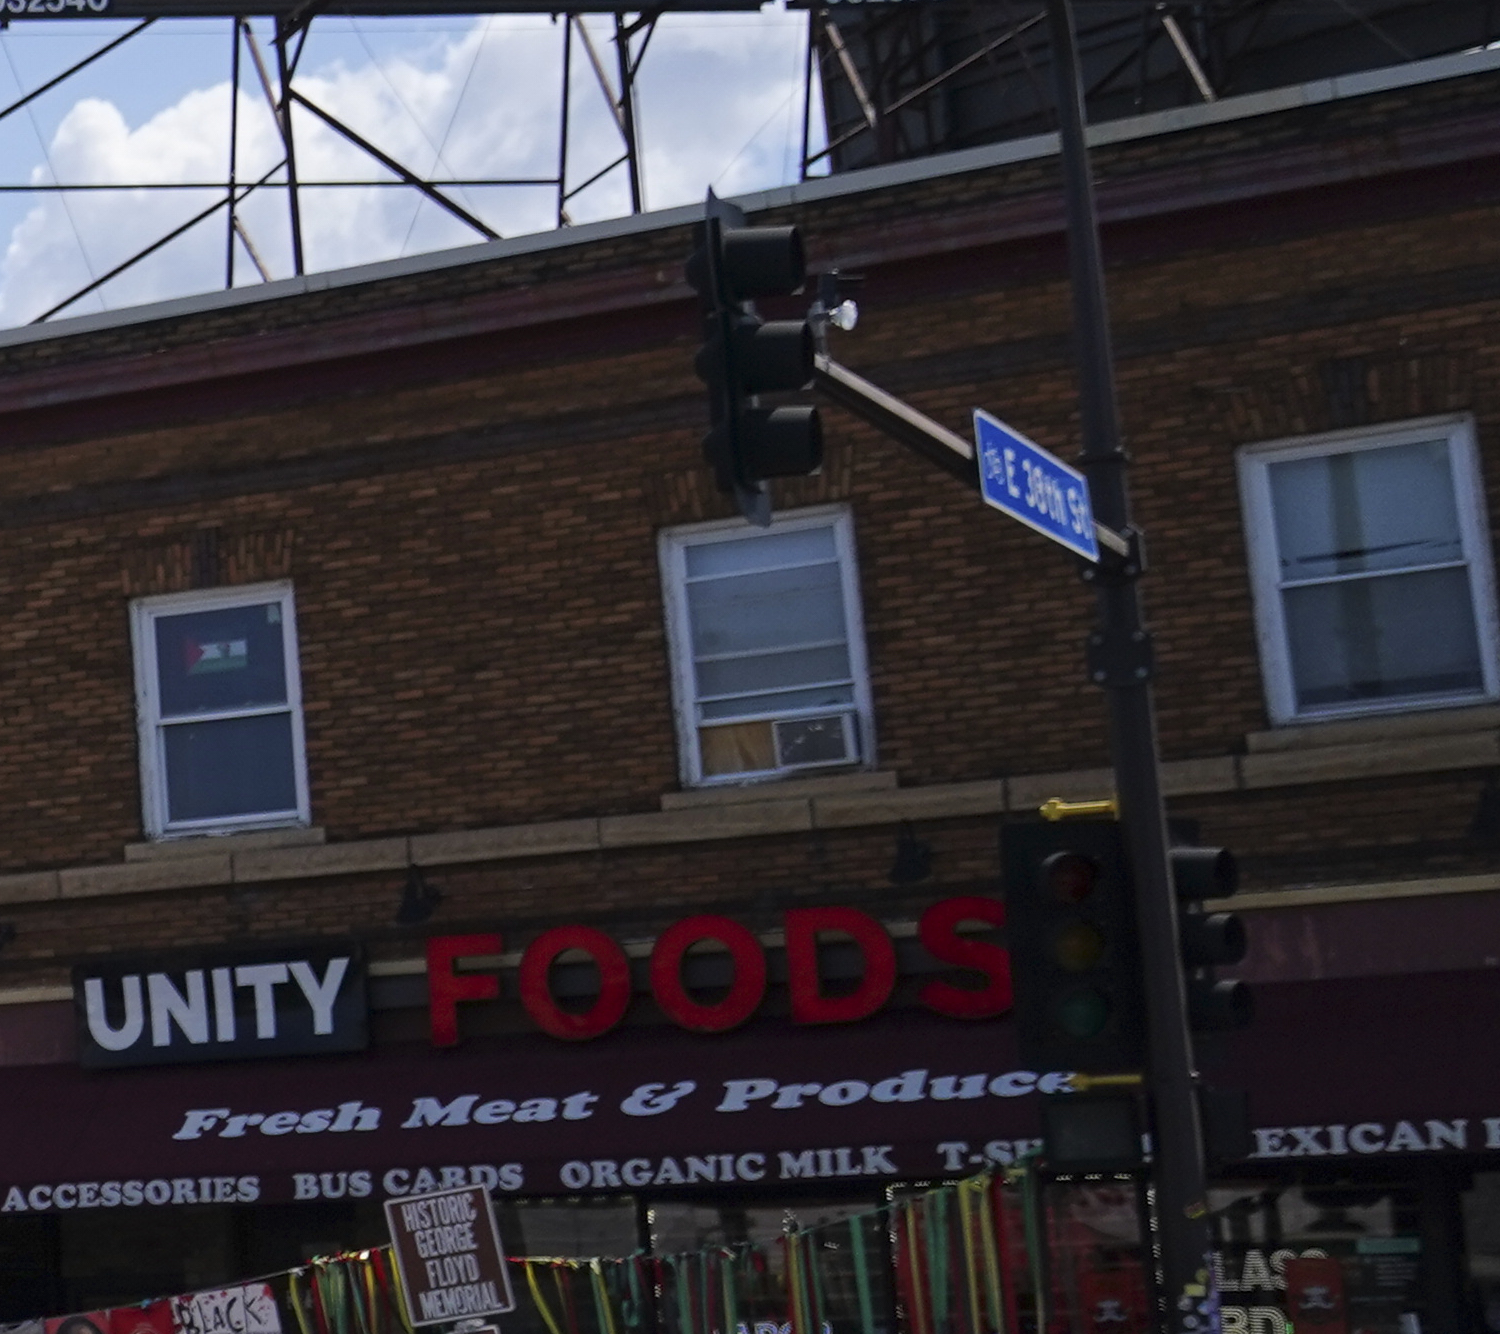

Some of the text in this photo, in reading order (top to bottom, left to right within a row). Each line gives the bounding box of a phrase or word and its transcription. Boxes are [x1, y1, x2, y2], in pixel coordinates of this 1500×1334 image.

[1002, 446, 1020, 499] E
[83, 896, 1014, 1053] UNITY FOODS
[170, 1068, 1079, 1142] Fresh Meat & Produce
[1250, 1118, 1469, 1161] EXICAN
[1, 1173, 261, 1214] ACCESSORIES
[293, 1169, 371, 1201] BUS
[382, 1162, 525, 1196] CARDS
[559, 1152, 767, 1191] ORGANIC
[779, 1145, 899, 1179] MILK
[400, 1192, 478, 1233] HISTORIC
[413, 1222, 479, 1260] GEORGE
[424, 1253, 481, 1290] FLOYD
[418, 1280, 505, 1320] MEMORIAL
